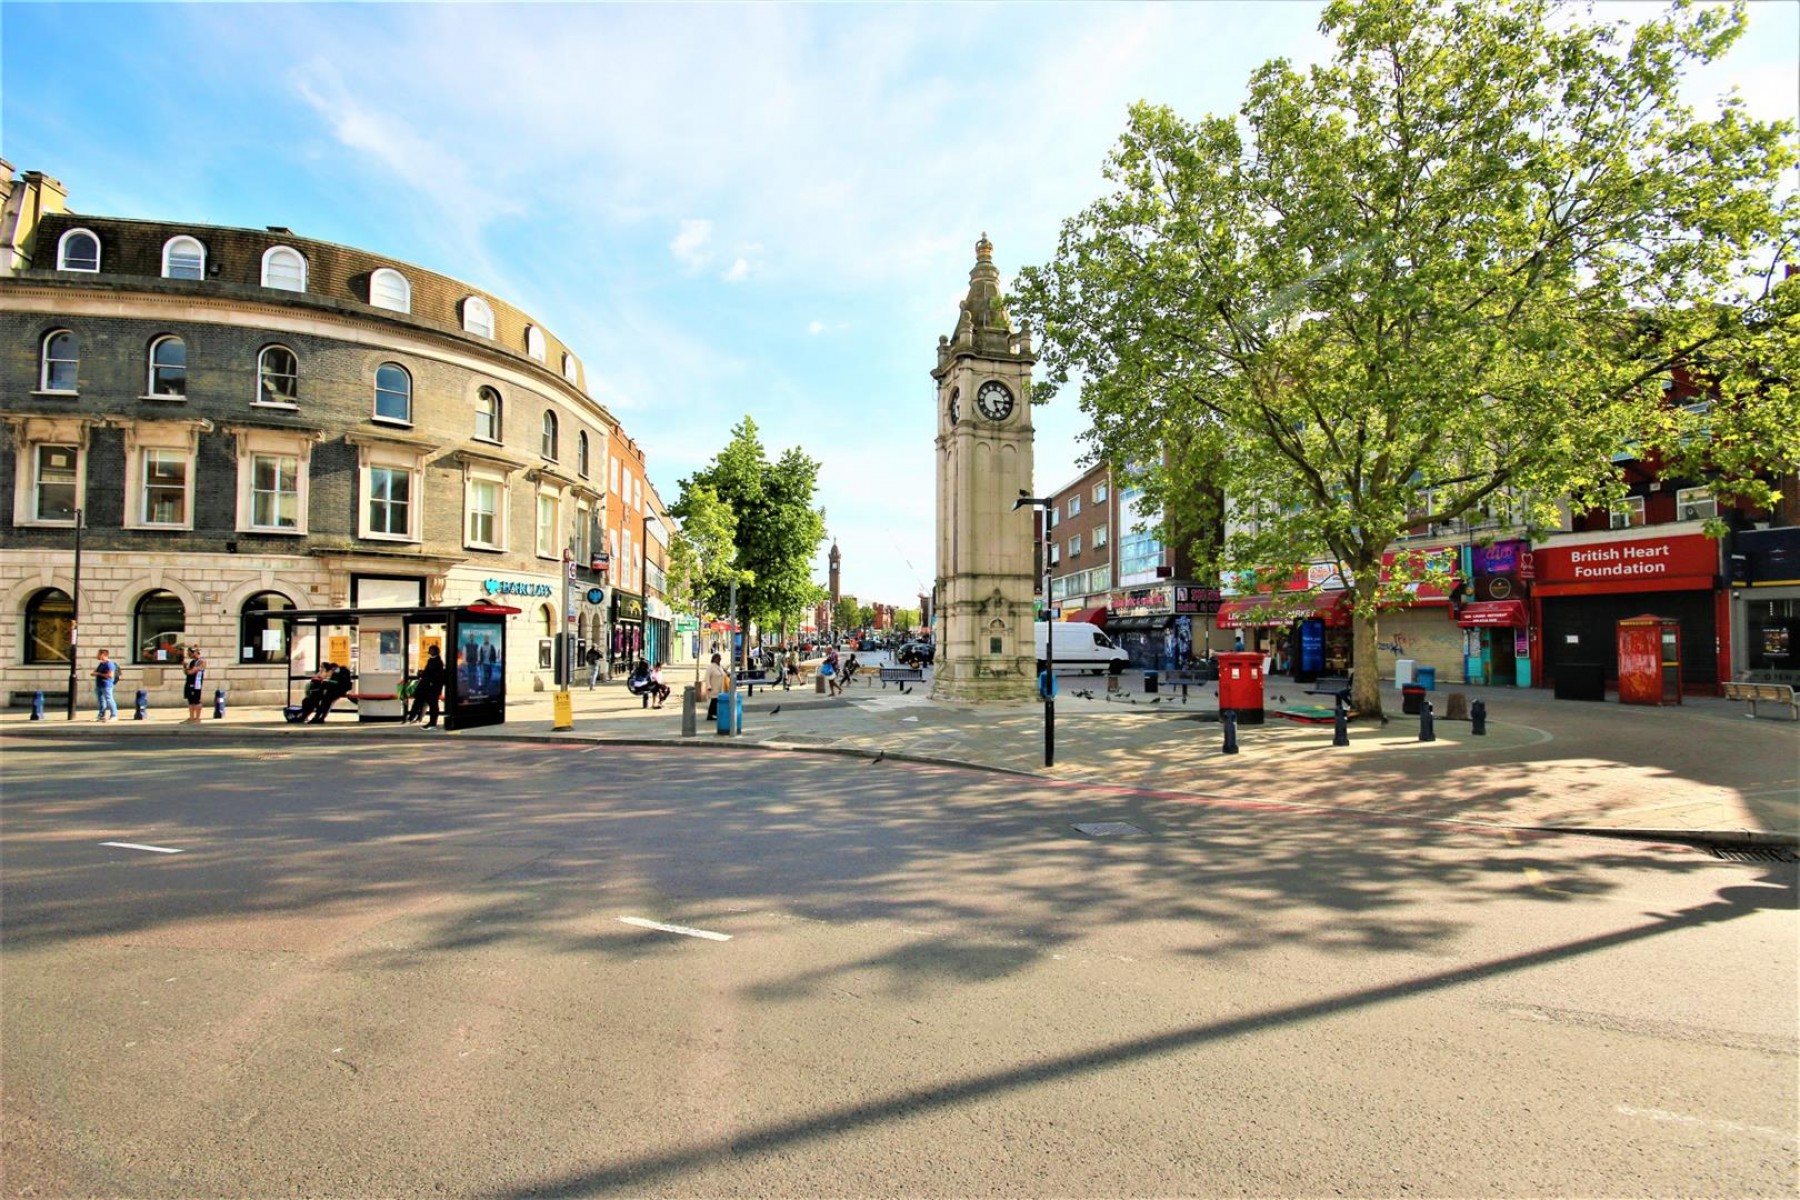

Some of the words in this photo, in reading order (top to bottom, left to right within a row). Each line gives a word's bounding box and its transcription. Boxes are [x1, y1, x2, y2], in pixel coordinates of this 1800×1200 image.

[1571, 548, 1620, 563] British
[1623, 545, 1669, 558] Heart
[1575, 561, 1665, 577] Foundation
[500, 580, 552, 598] BARCLAYS
